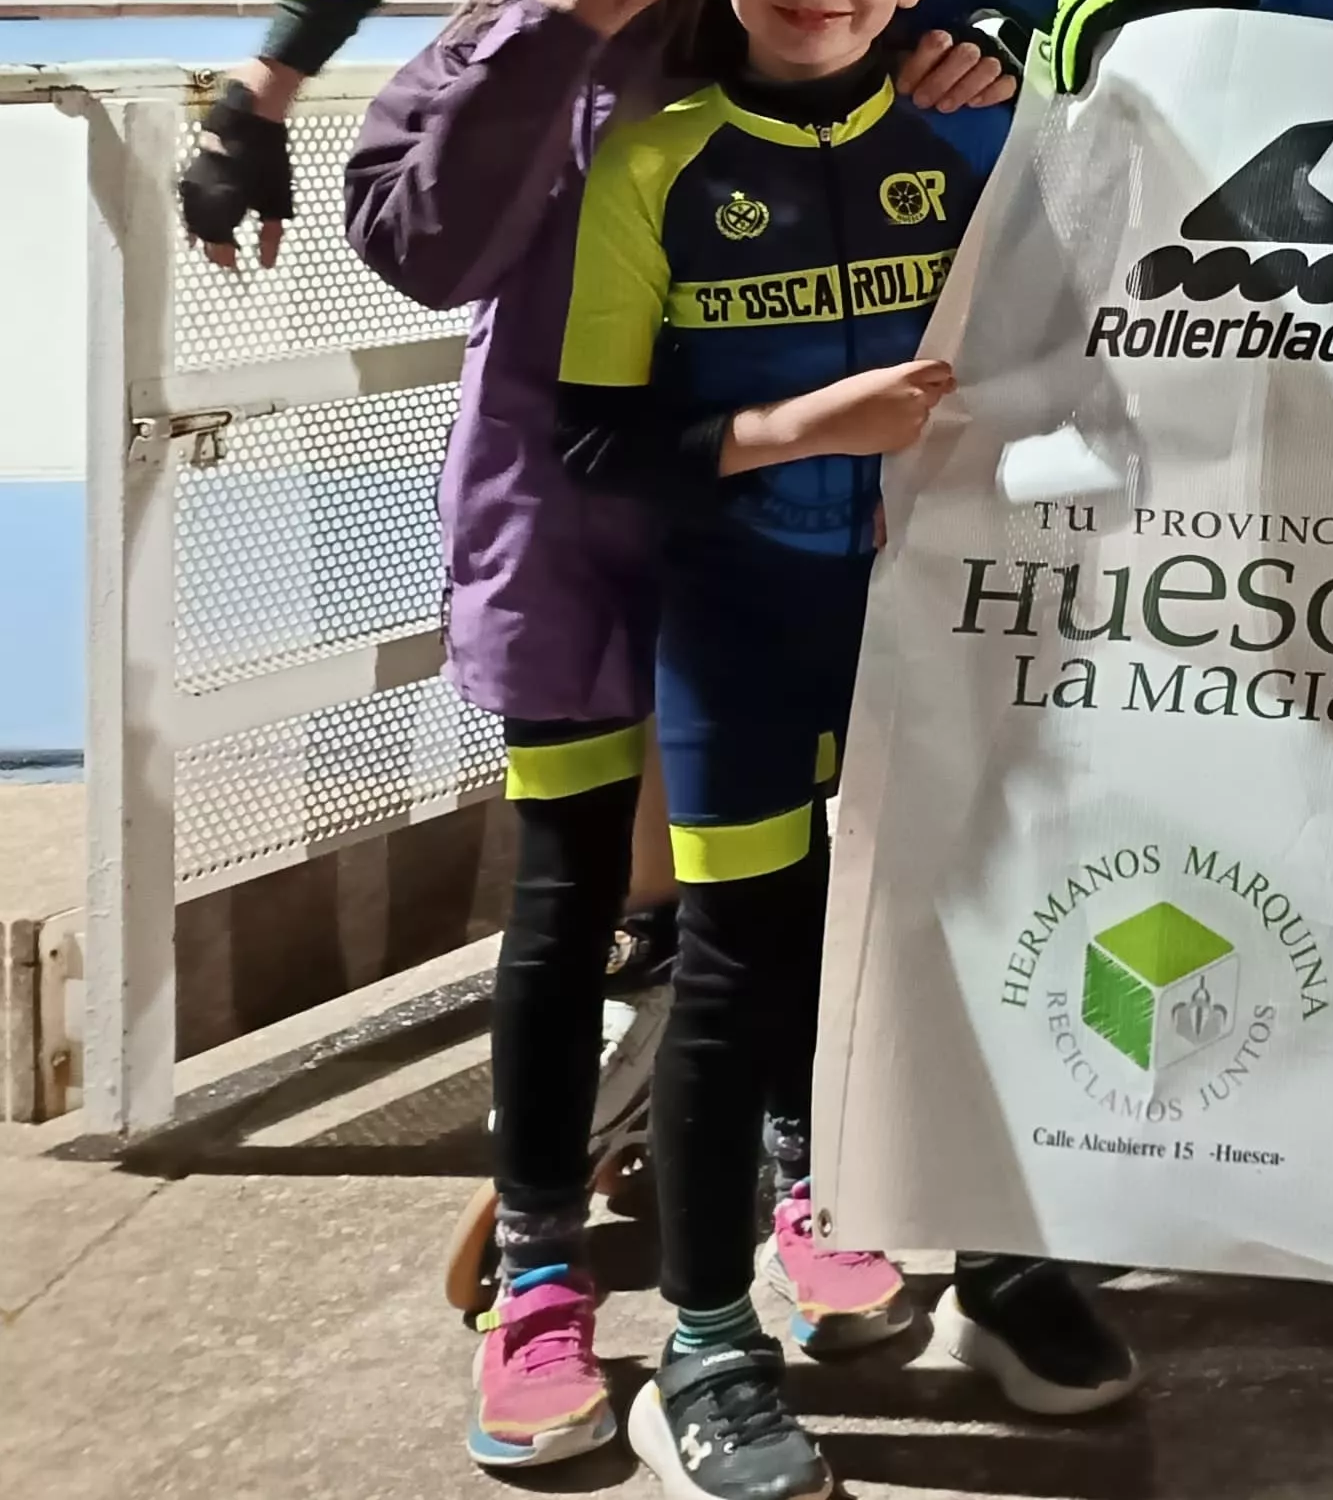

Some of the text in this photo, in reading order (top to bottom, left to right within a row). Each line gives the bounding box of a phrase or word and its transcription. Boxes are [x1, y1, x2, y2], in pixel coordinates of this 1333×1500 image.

[696, 287, 733, 323] CP
[739, 273, 837, 319] OSCA
[1001, 844, 1330, 1021] HERMANOS MARQUINA
[1046, 990, 1277, 1124] RECICLAMOS JUNTOS
[1032, 1126, 1286, 1167] Calle Alcubierre 15 -Huesca-
